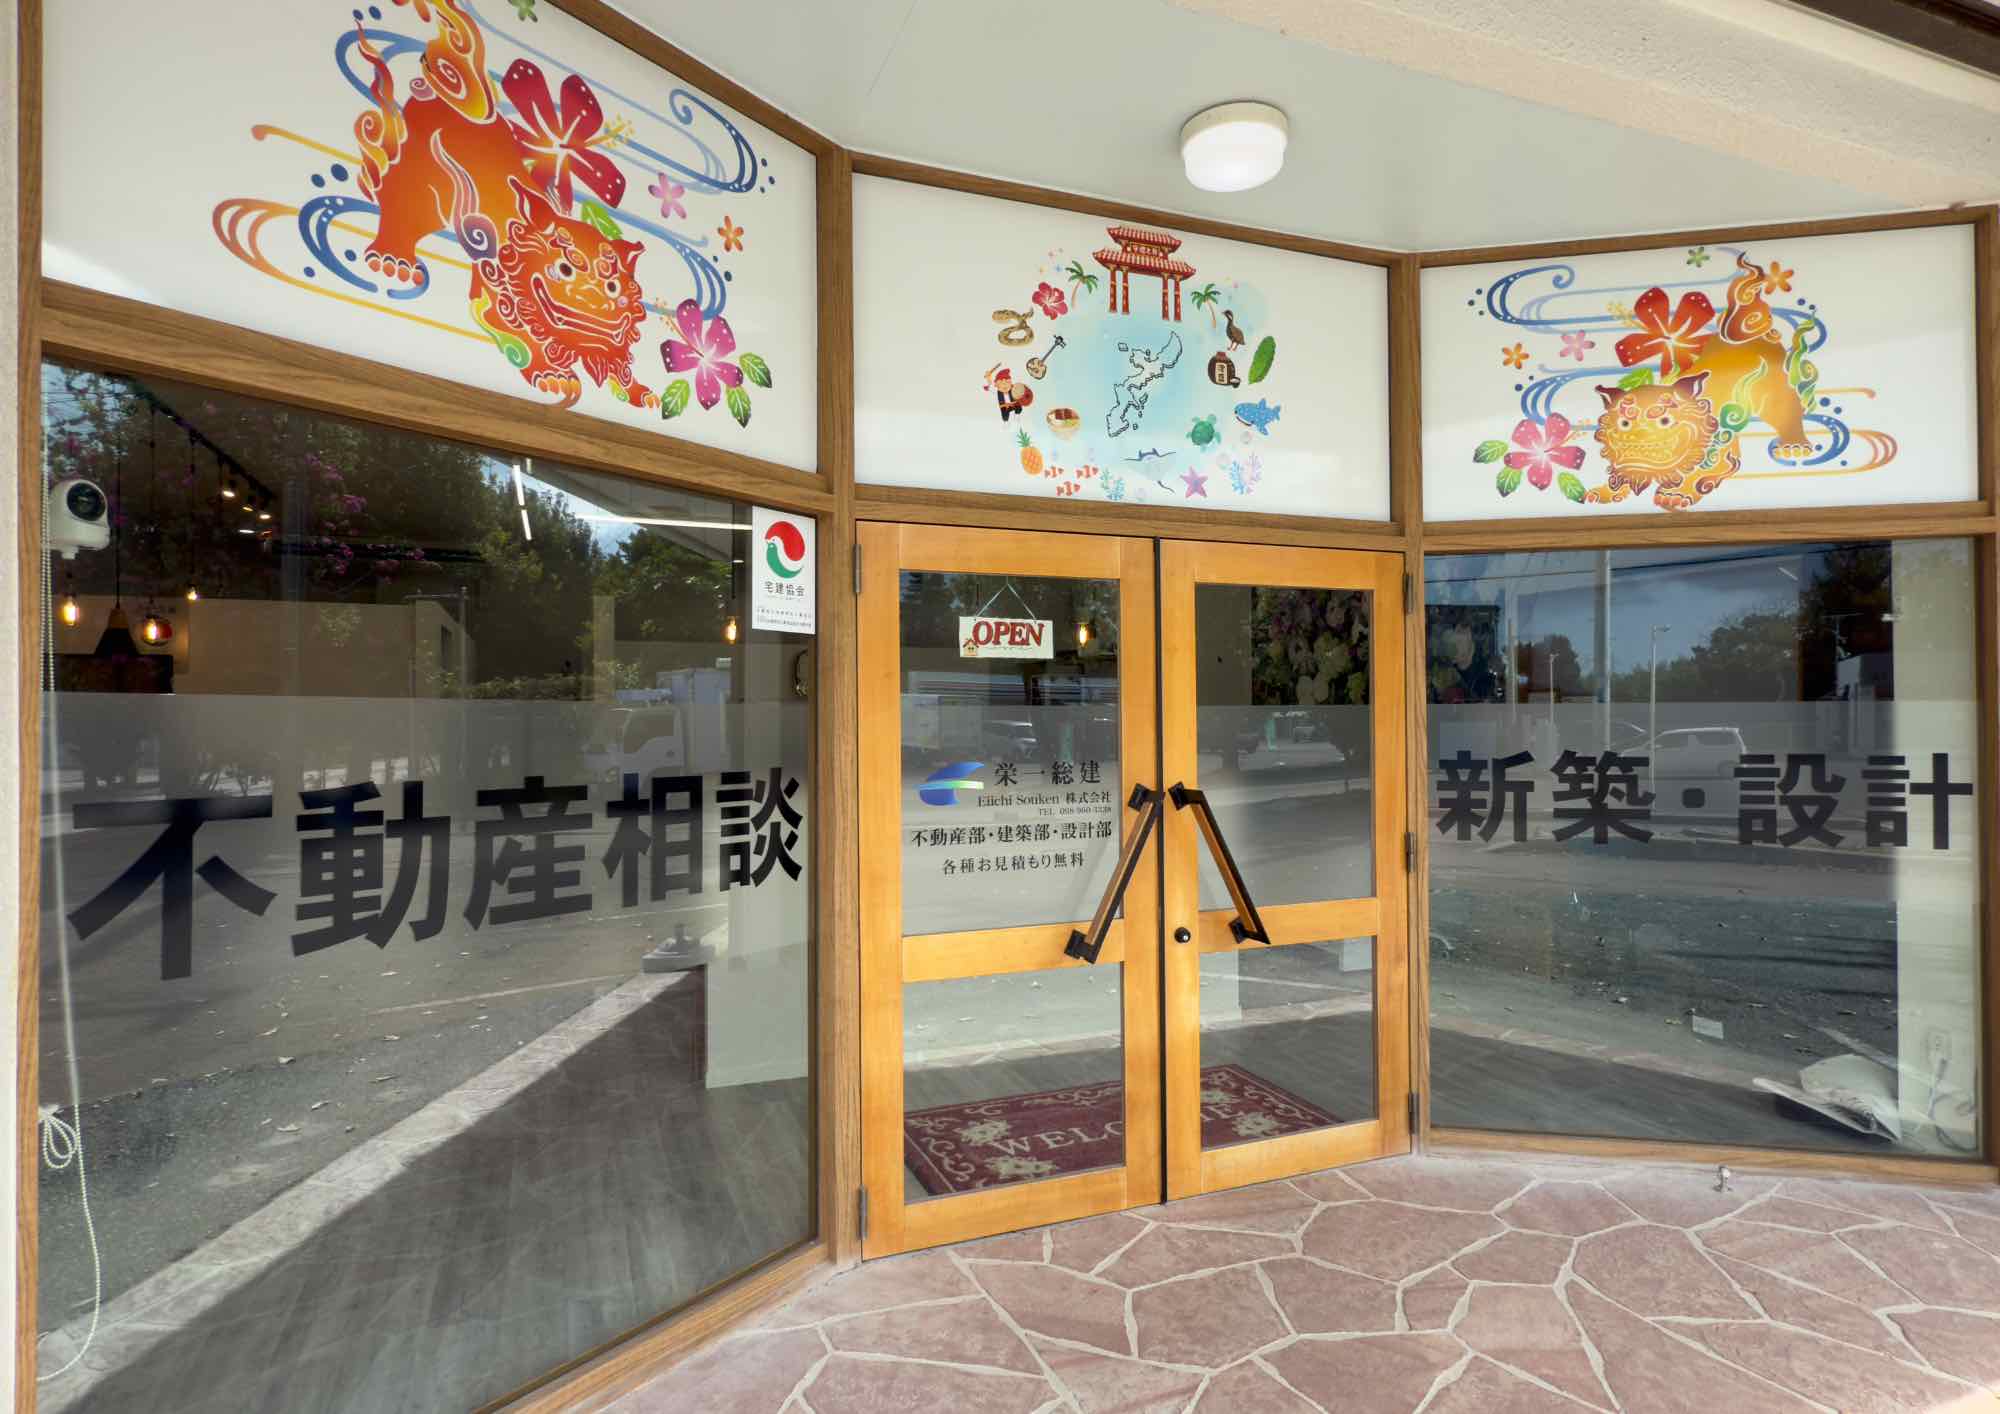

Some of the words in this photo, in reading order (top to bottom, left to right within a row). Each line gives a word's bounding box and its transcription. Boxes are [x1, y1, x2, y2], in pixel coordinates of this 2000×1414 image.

[972, 620, 1044, 646] OPEN
[994, 759, 1102, 786] 栄一総建
[1066, 791, 1112, 804] 株式会社
[66, 766, 804, 981] 不動産相談
[943, 851, 1084, 875] 各種お見積もり無料
